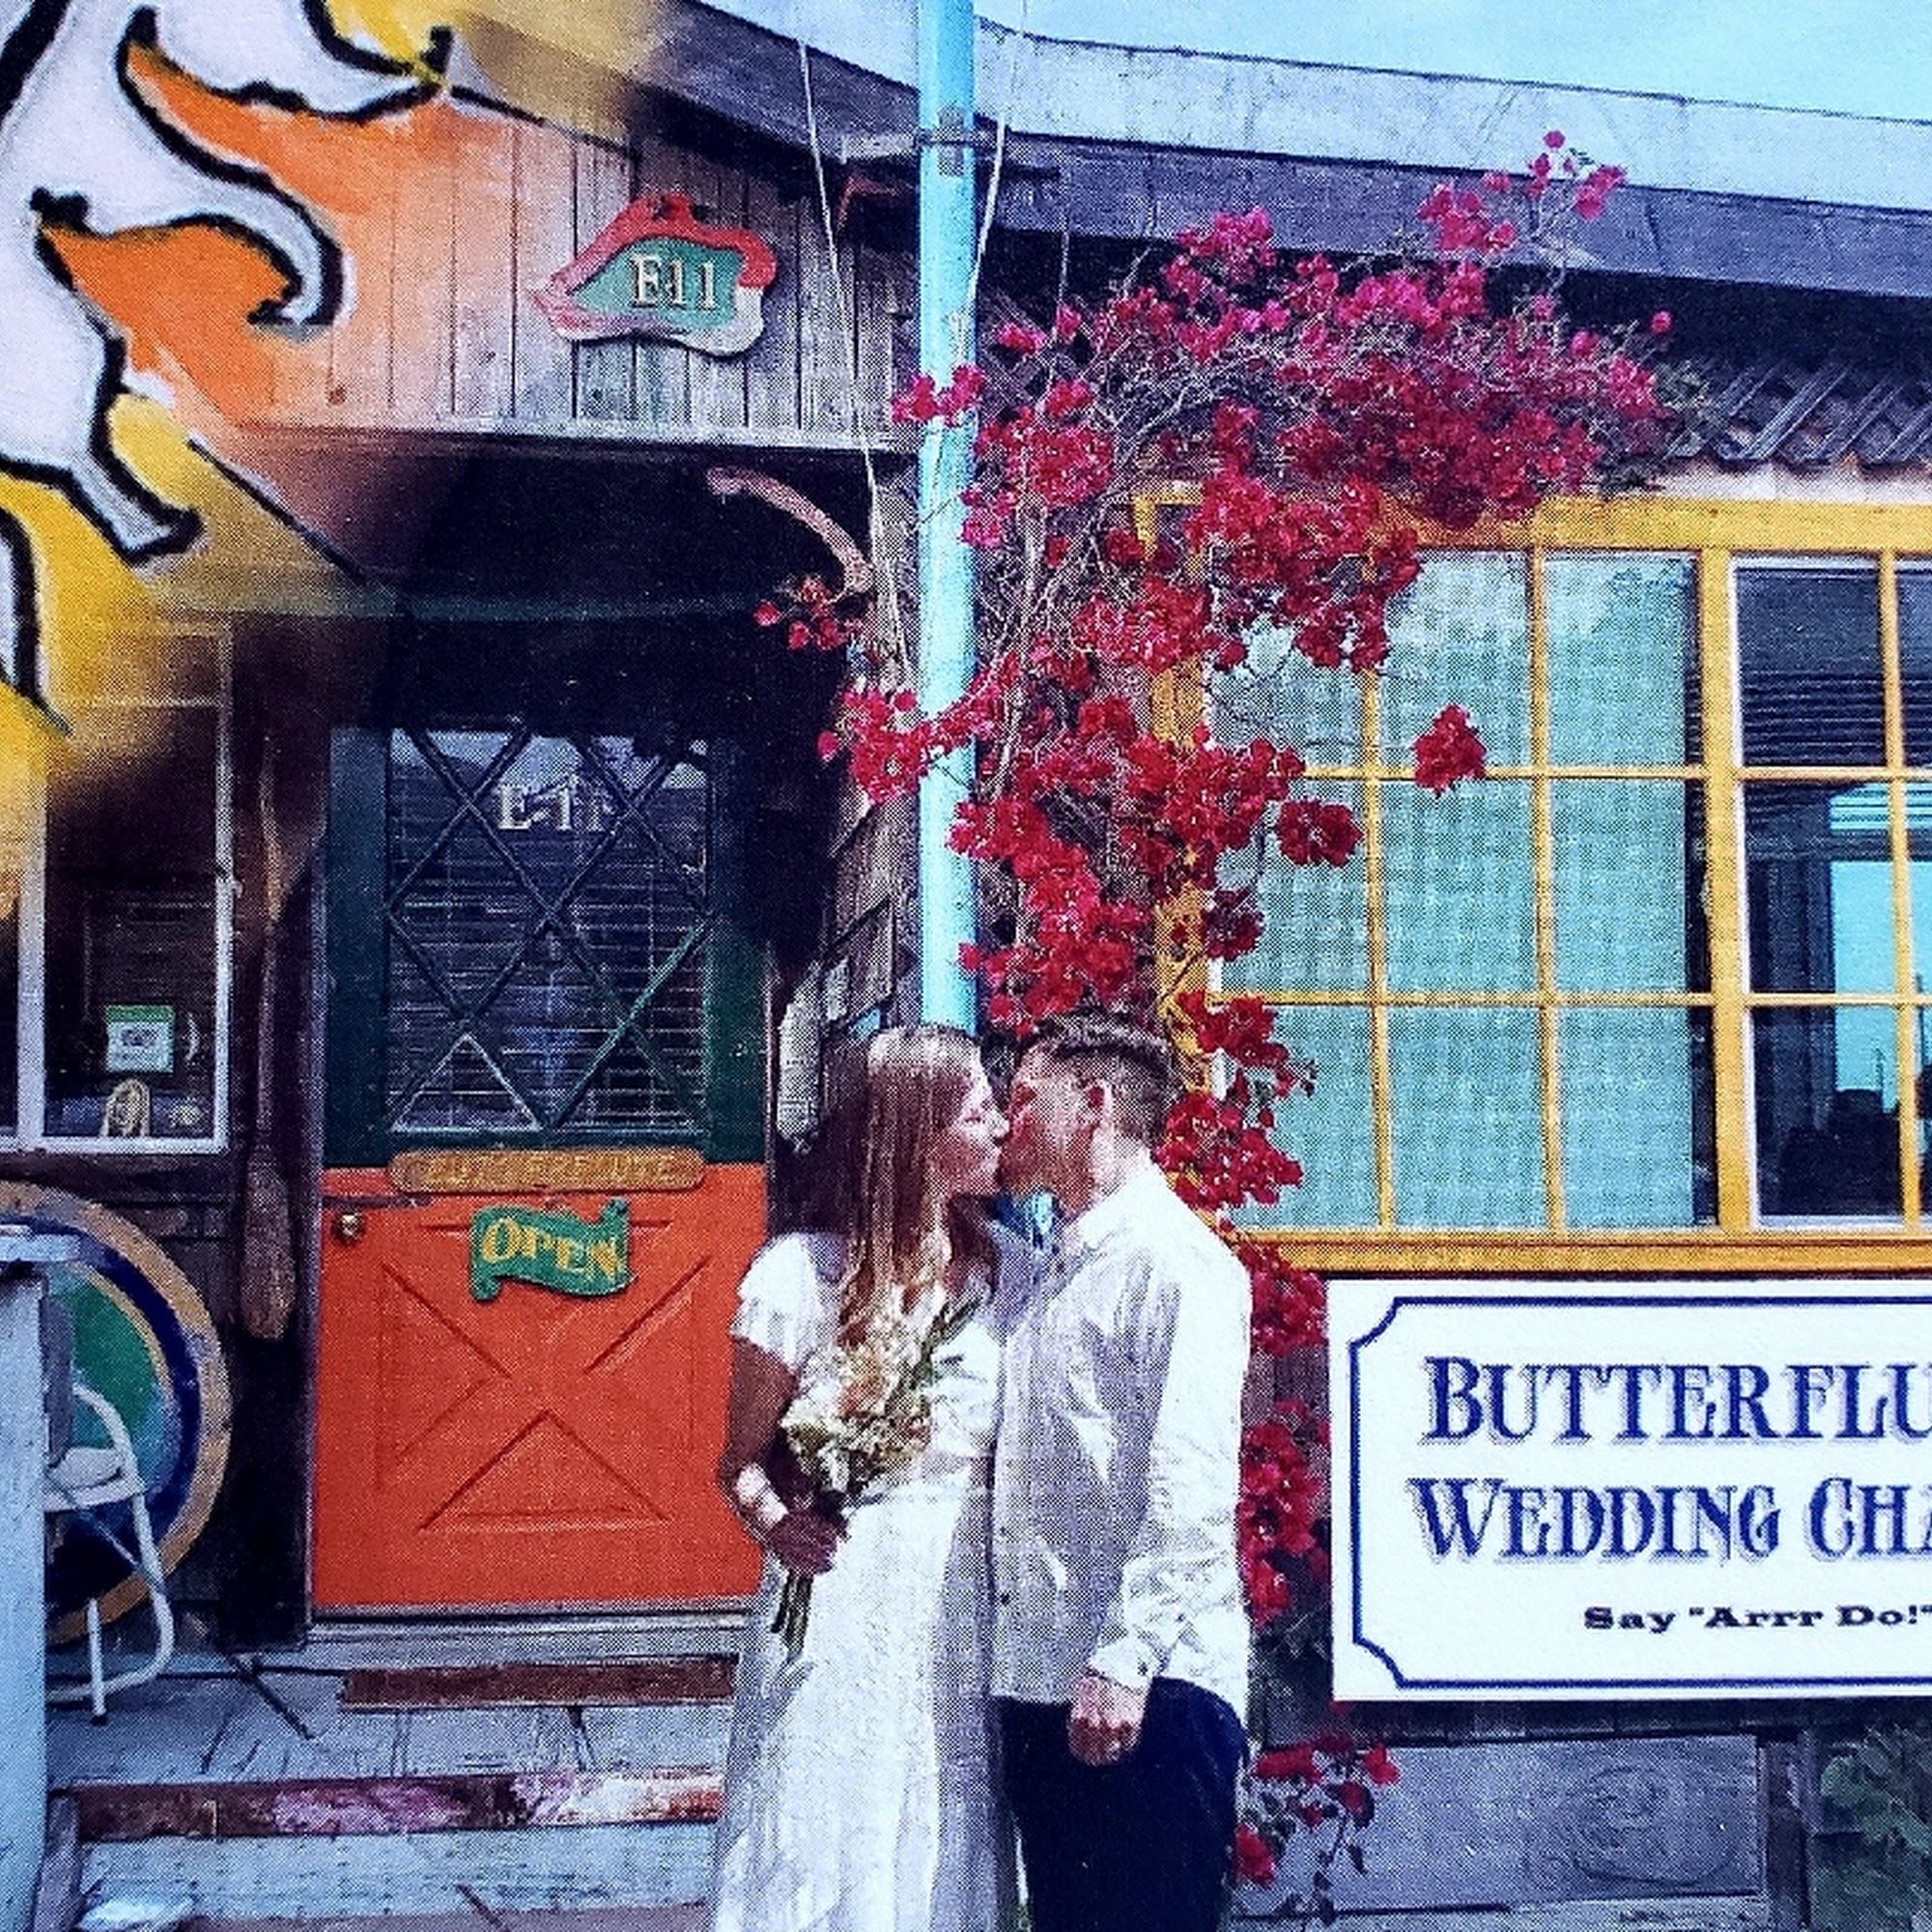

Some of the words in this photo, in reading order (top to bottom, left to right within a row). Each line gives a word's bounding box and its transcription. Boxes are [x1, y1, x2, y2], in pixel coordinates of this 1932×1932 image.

[483, 1217, 623, 1282] OPEN
[1419, 1355, 1932, 1445] BUTTERFLU
[1406, 1477, 1782, 1564] WEDDING
[1583, 1605, 1676, 1634] Say
[1689, 1605, 1824, 1630] "Arrr
